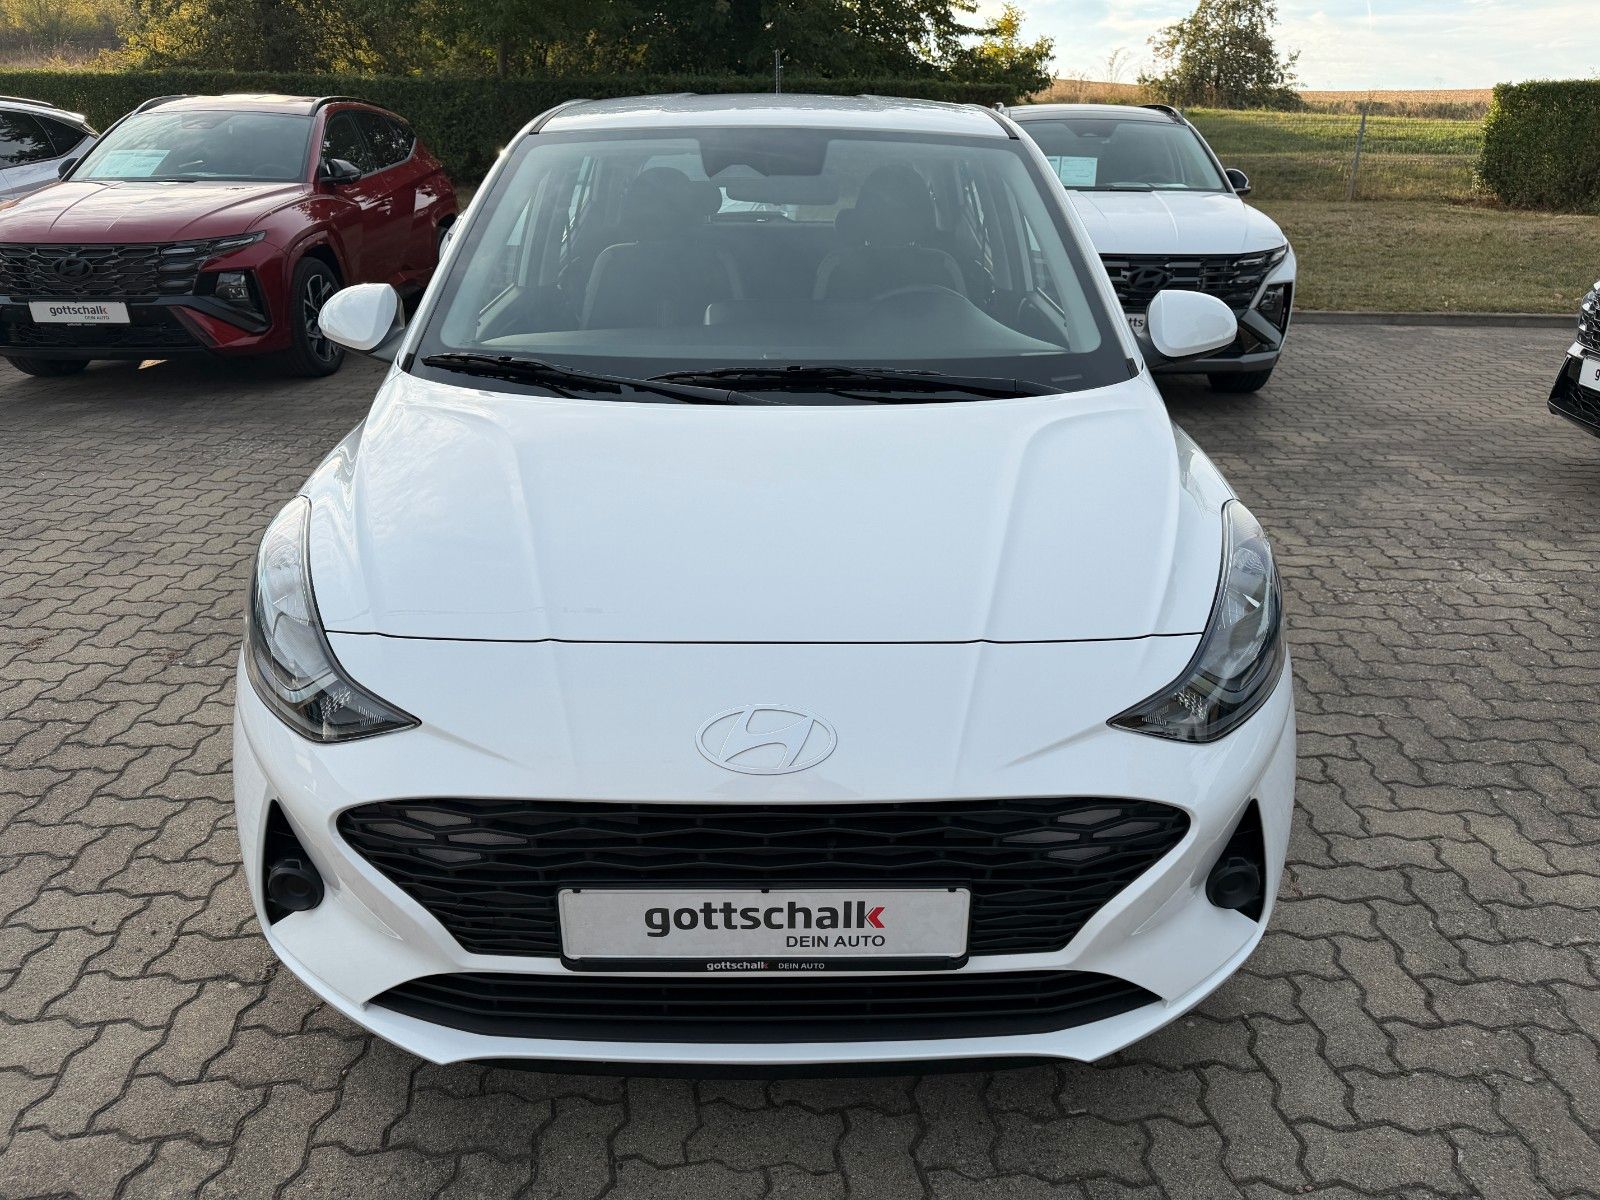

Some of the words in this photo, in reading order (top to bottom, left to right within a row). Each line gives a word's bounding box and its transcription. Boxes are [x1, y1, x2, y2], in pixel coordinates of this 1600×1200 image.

[49, 305, 108, 316] gottschalk
[644, 901, 886, 937] gottschalk
[786, 935, 829, 948] DEIN
[833, 935, 886, 948] AUTO
[706, 961, 768, 971] gottschalk
[778, 962, 799, 970] DEIN
[800, 962, 825, 970] AUTO
